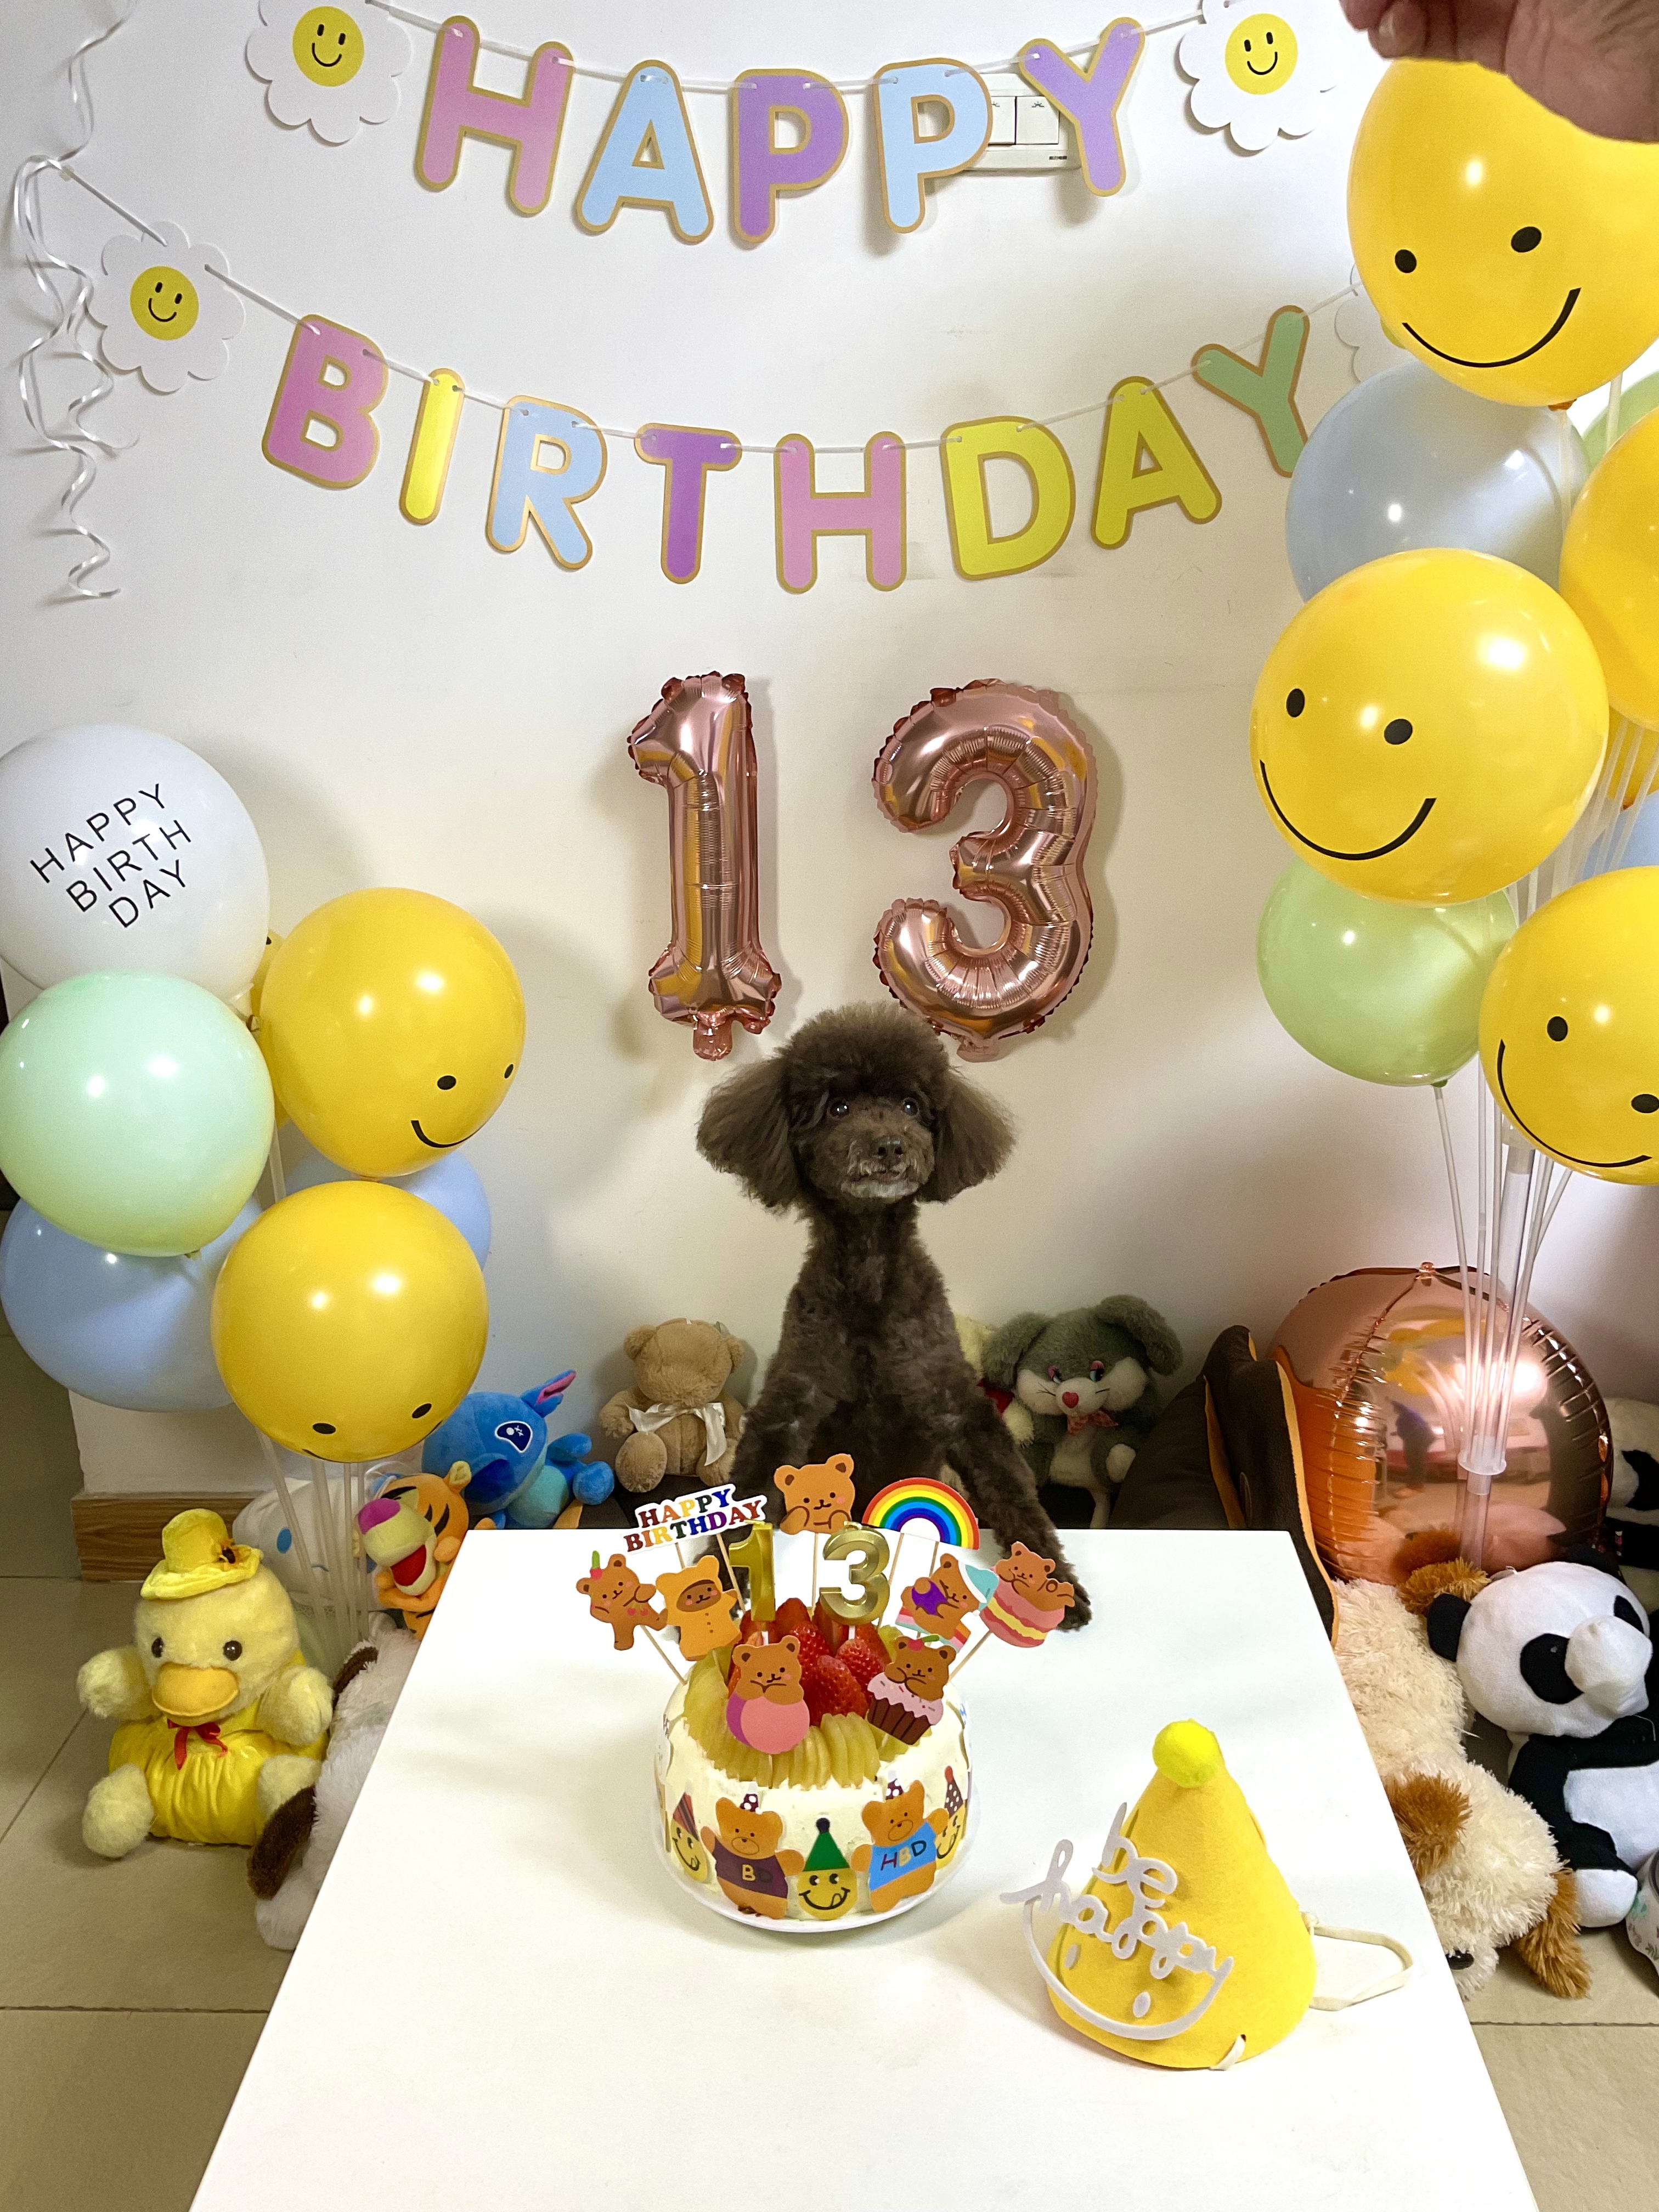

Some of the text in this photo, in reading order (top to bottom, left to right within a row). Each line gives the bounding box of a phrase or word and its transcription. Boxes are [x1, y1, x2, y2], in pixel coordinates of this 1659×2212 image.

[415, 16, 1146, 244] HAPPY
[262, 305, 1310, 594] BIRTHDAY
[30, 783, 165, 883] HAPPY
[66, 820, 191, 912] BIRTH
[109, 859, 185, 928] DAY
[623, 1499, 761, 1552] BIRTHDAY
[638, 1488, 731, 1528] HAPPY
[880, 1840, 927, 1871] HBD
[1091, 1802, 1177, 1907] be
[999, 1839, 1234, 1983] happy
